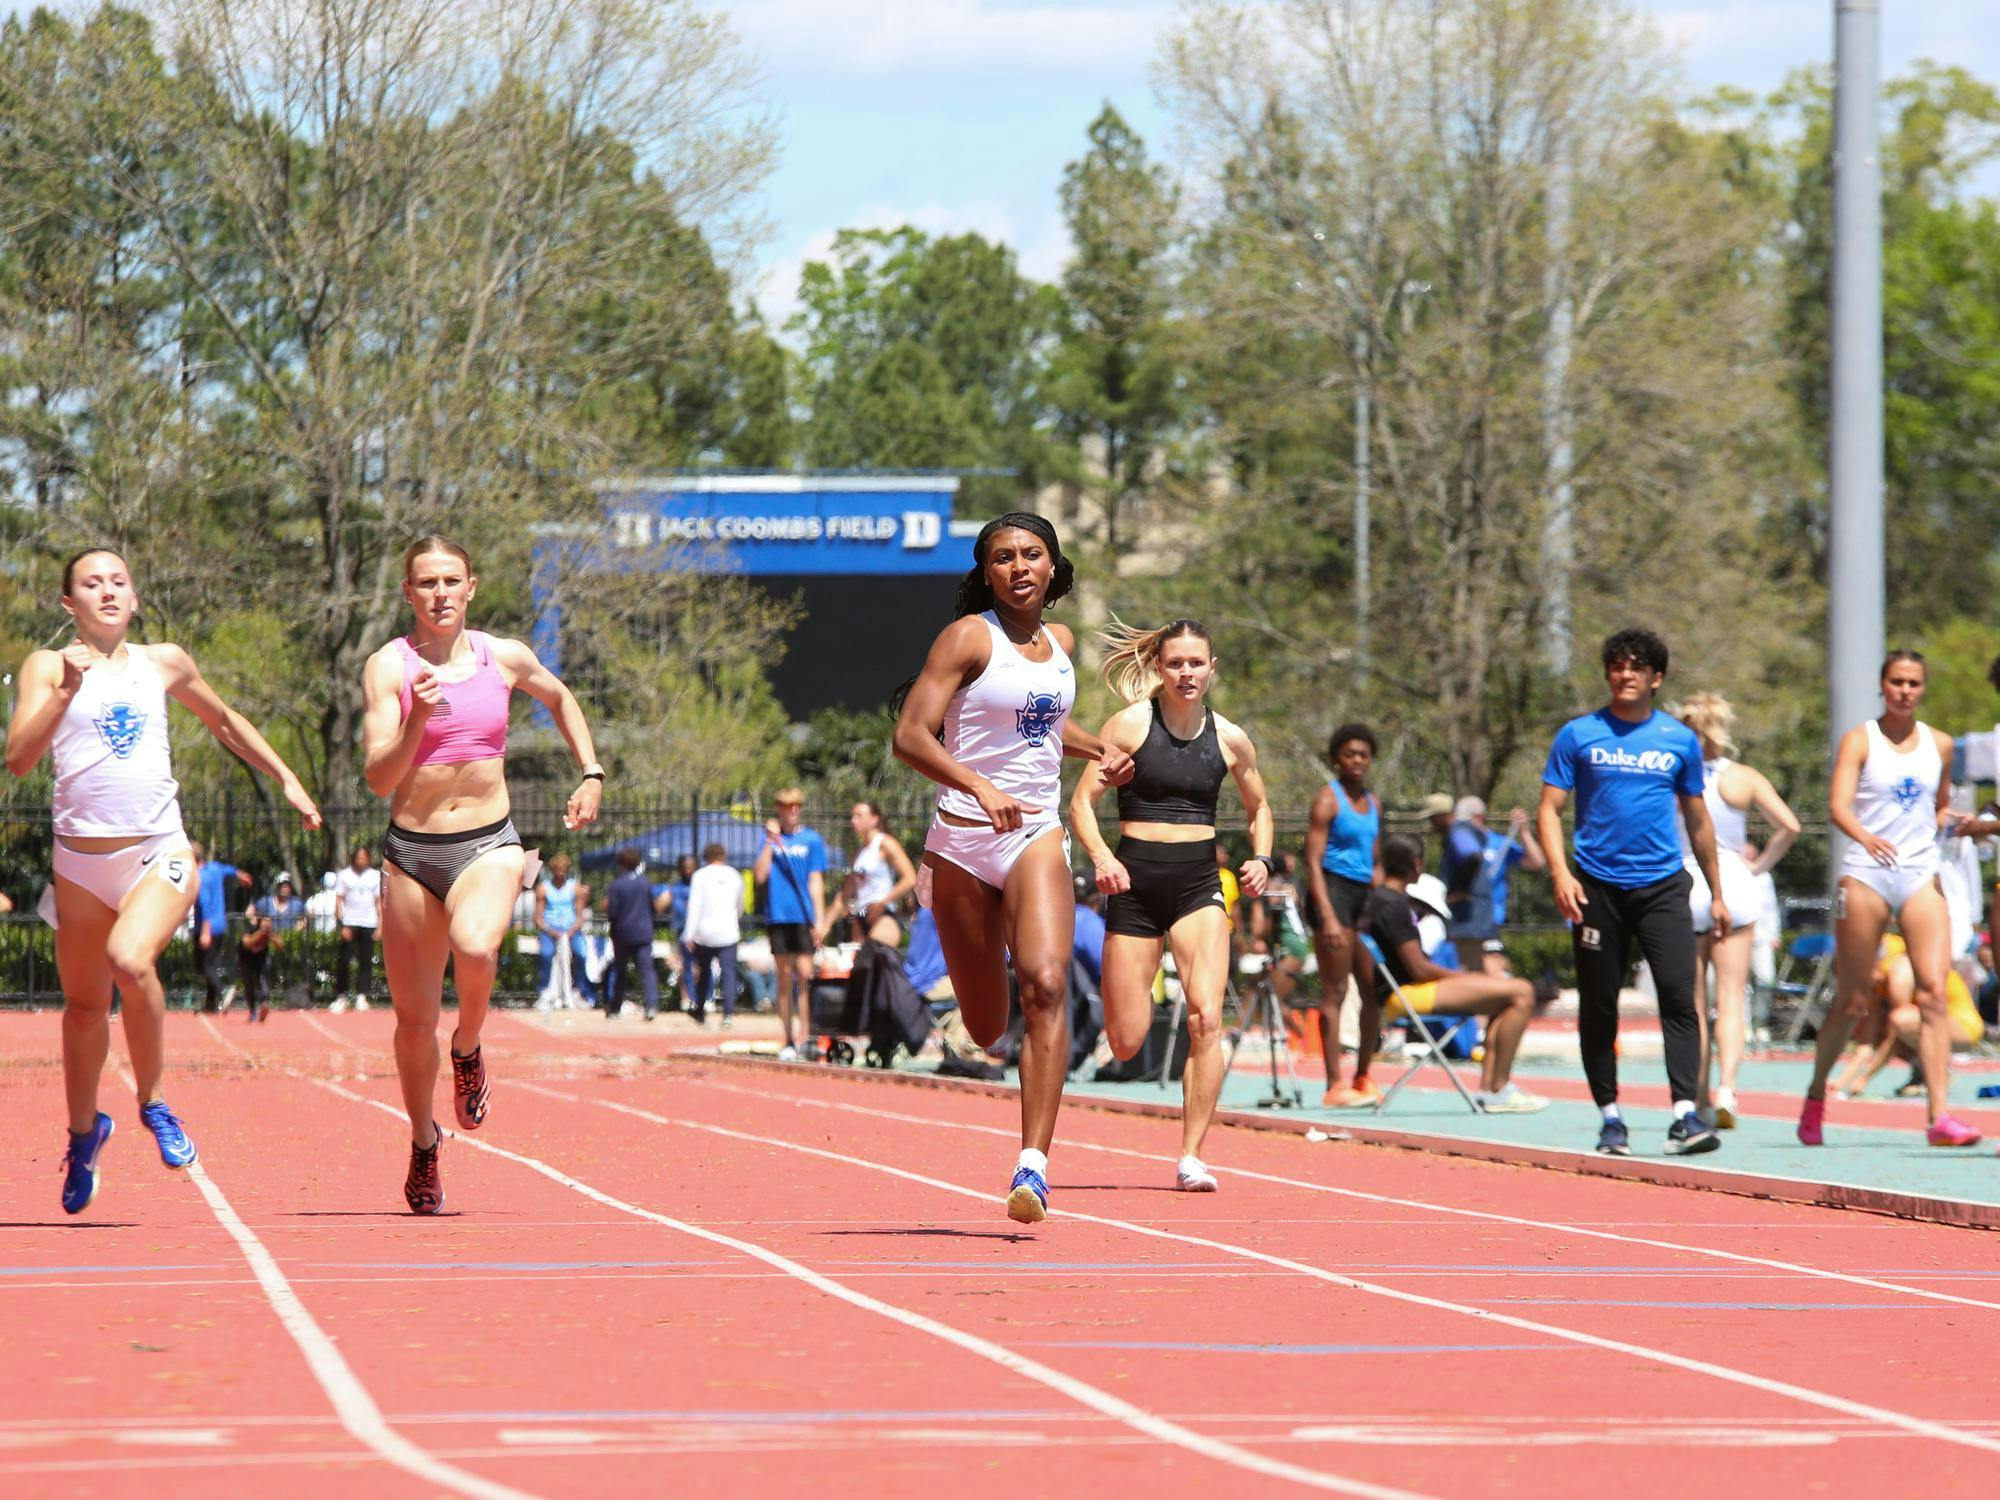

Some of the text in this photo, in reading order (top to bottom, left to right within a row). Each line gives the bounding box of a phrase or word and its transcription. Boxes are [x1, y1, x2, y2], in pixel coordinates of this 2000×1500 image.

[659, 517, 714, 539] JACK
[717, 516, 823, 541] COOMBS
[826, 516, 898, 540] FIELD
[902, 511, 941, 548] D
[168, 860, 183, 884] 5
